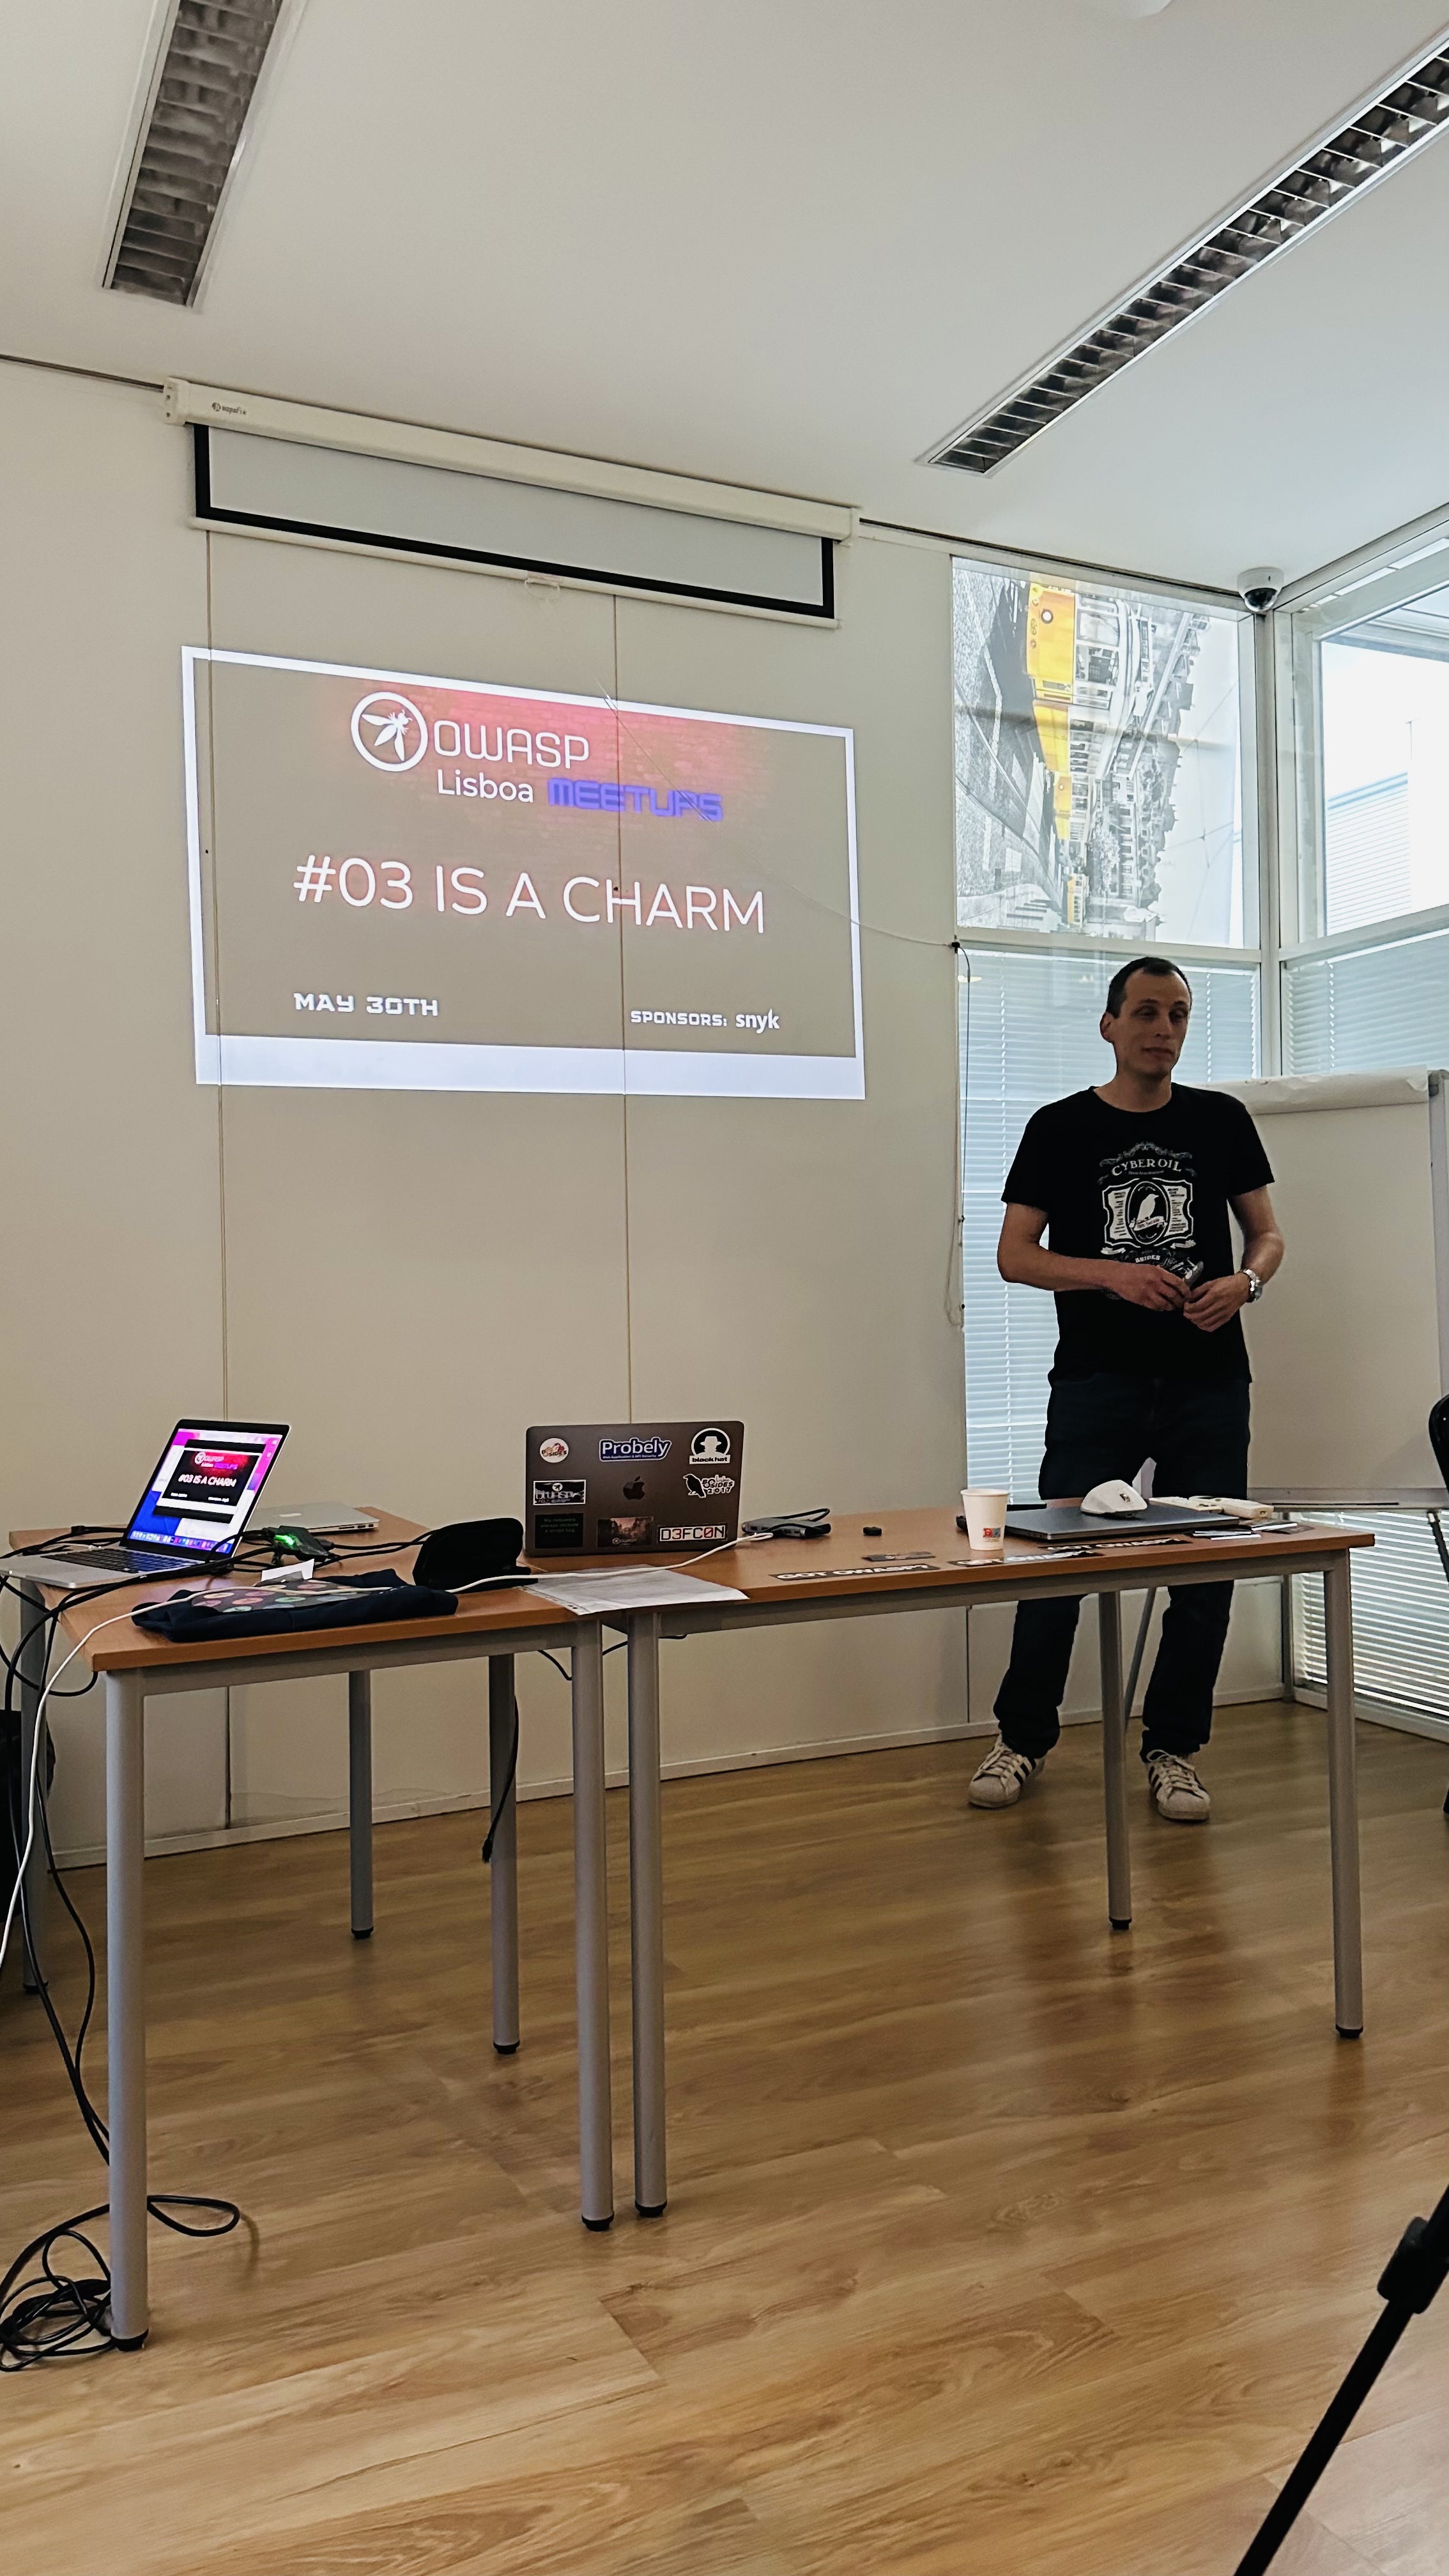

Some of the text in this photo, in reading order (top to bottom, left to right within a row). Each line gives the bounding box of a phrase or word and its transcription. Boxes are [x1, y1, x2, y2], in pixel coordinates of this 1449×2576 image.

[433, 719, 590, 769] OWASP
[437, 769, 723, 822] Lisboa MEETUPS
[293, 854, 765, 934] #03 IS A CHARM
[293, 993, 438, 1016] MAY 30TH
[631, 1008, 780, 1034] SPONSORS: snyk
[1112, 1158, 1182, 1176] CYBER OIL
[602, 1439, 669, 1457] Probely
[208, 1476, 237, 1487] CHARM
[777, 1571, 827, 1579] GOT
